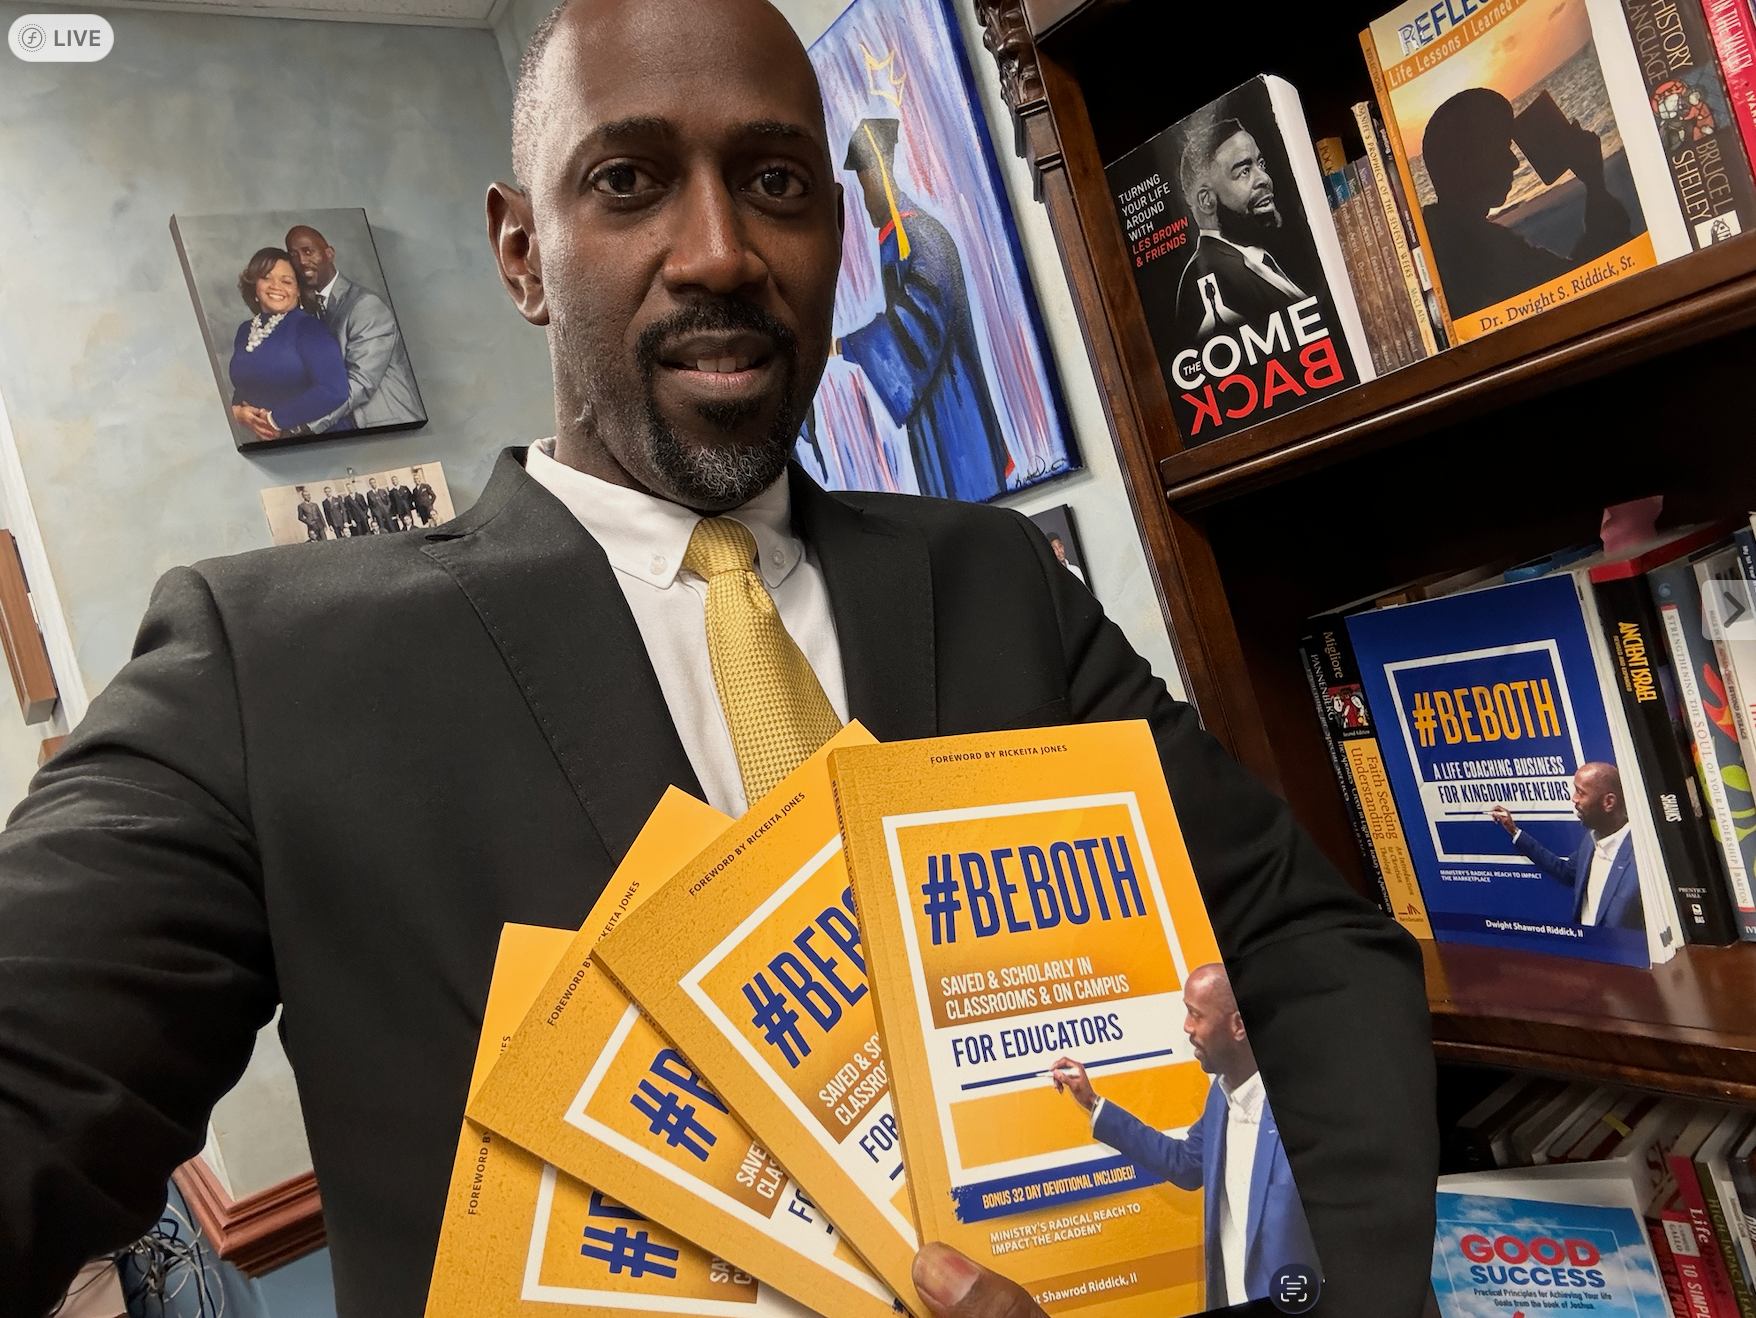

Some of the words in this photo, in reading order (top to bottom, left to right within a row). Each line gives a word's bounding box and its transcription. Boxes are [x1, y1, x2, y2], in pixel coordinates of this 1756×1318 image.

[1398, 0, 1490, 57] REFLE
[1715, 8, 1742, 36] THE
[1388, 63, 1414, 87] Life
[1415, 35, 1462, 73] Lessons
[1471, 0, 1513, 37] Learned
[1723, 30, 1754, 77] VALLEY
[1357, 103, 1373, 139] DANIEL'S
[1380, 128, 1392, 154] planting
[1367, 142, 1384, 183] PROPHECY
[1696, 139, 1732, 199] BRUCE
[1118, 173, 1161, 204] TURNING
[1121, 196, 1148, 217] YOUR
[1148, 182, 1171, 203] LIFE
[1380, 186, 1389, 198] OF
[1672, 149, 1713, 221] SHELLEY
[1126, 200, 1165, 231] AROUND
[1384, 199, 1394, 215] THE
[1128, 221, 1155, 242] WITH
[1132, 237, 1152, 255] LES
[1152, 216, 1189, 245] BROWN
[1389, 218, 1406, 250] SEVENTY
[1136, 256, 1144, 268] &
[1145, 232, 1187, 263] FRIENDS
[1400, 252, 1414, 279] WEEKS
[1410, 287, 1427, 324] McCLAIN
[1479, 316, 1503, 332] Dr.
[1505, 291, 1556, 322] Dwight
[1557, 286, 1570, 300] S.
[1571, 262, 1620, 295] Riddick,
[1619, 255, 1636, 272] Sr.
[1171, 295, 1330, 390] COME
[1182, 360, 1202, 376] THE
[1323, 631, 1344, 679] Migliore
[1618, 622, 1649, 667] ANCIENT
[1667, 614, 1695, 696] STRENGTHENING
[1311, 654, 1335, 721] PANNENBERG
[1629, 667, 1657, 704] ISRAEL
[1727, 685, 1740, 711] BEYOND
[1412, 678, 1562, 747] #BEBOTH
[1689, 699, 1701, 718] THE
[930, 753, 982, 764] FOREWORD
[984, 751, 996, 759] BY
[998, 747, 1039, 758] RICKEITA
[1040, 744, 1068, 755] JONES
[1694, 721, 1712, 760] SOUL
[1432, 763, 1442, 780] A
[1443, 761, 1463, 780] LIFE
[1463, 759, 1513, 779] COACHING
[1513, 756, 1566, 777] BUSINESS
[1706, 762, 1717, 775] OF
[1351, 747, 1385, 840] Understanding
[1367, 755, 1385, 788] Faith
[1377, 791, 1398, 840] Seeking
[1437, 785, 1461, 804] FOR
[1461, 781, 1571, 803] KINGDOMPRENEURS
[1660, 793, 1683, 823] SHANKS
[1710, 777, 1725, 804] YOUR
[688, 854, 735, 896] FOREWORD
[734, 843, 747, 856] BY
[746, 813, 782, 845] RICKEITA
[780, 791, 806, 816] JONES
[1718, 806, 1739, 866] LEADERSHIP
[921, 835, 1147, 945] #BEBOTH
[1734, 872, 1749, 904] BARTON
[1485, 919, 1512, 931] Dwight
[1513, 922, 1545, 934] Shawrod
[1546, 926, 1577, 938] Riddick,
[1577, 929, 1584, 938] II
[547, 969, 585, 1026] FOREWORD
[618, 880, 640, 911] JONES
[940, 972, 985, 996] SAVED
[987, 970, 1000, 989] &
[1000, 958, 1075, 987] SCHOLARLY
[1076, 956, 1093, 976] IN
[945, 989, 1038, 1021] CLASSROOMS
[1039, 985, 1052, 1005] &
[1052, 982, 1074, 1002] ON
[1075, 974, 1130, 999] CAMPUS
[951, 1033, 997, 1068] FOR
[1000, 1012, 1124, 1059] EDUCATORS
[818, 1065, 860, 1108] SAVED
[853, 1052, 872, 1071] &
[834, 1059, 888, 1126] CLASSRO
[468, 1147, 489, 1215] FOREWORD
[981, 1189, 1013, 1209] BONUS
[1012, 1186, 1024, 1204] 32
[1025, 1184, 1042, 1201] DAY
[1043, 1174, 1093, 1197] DEVOTIONAL
[1092, 1164, 1137, 1187] INCLUDED!
[990, 1221, 1047, 1243] MINISTRY'S
[1048, 1213, 1092, 1231] RADICAL
[1093, 1206, 1126, 1222] REACH
[1127, 1202, 1141, 1214] TO
[992, 1240, 1033, 1256] IMPACT
[1033, 1233, 1052, 1247] THE
[1053, 1223, 1102, 1242] ACADEMY
[1690, 1208, 1711, 1244] Life
[1460, 1233, 1601, 1267] GOOD
[1042, 1282, 1087, 1303] Shawrod
[1088, 1275, 1129, 1293] Riddick,
[1129, 1272, 1138, 1283] II
[1470, 1265, 1606, 1288] SUCCESS
[1682, 1264, 1698, 1278] 10
[1474, 1288, 1502, 1297] Practical
[1503, 1289, 1537, 1299] Principles
[1538, 1290, 1548, 1298] for
[1549, 1290, 1583, 1301] Achieving
[1583, 1292, 1599, 1300] Your
[1494, 1298, 1513, 1307] Goals
[1514, 1299, 1530, 1307] from
[1531, 1299, 1542, 1308] the
[1542, 1300, 1560, 1309] book
[1561, 1300, 1569, 1309] of
[1569, 1301, 1596, 1310] Joshua.
[1687, 1282, 1712, 1318] SIMPL
